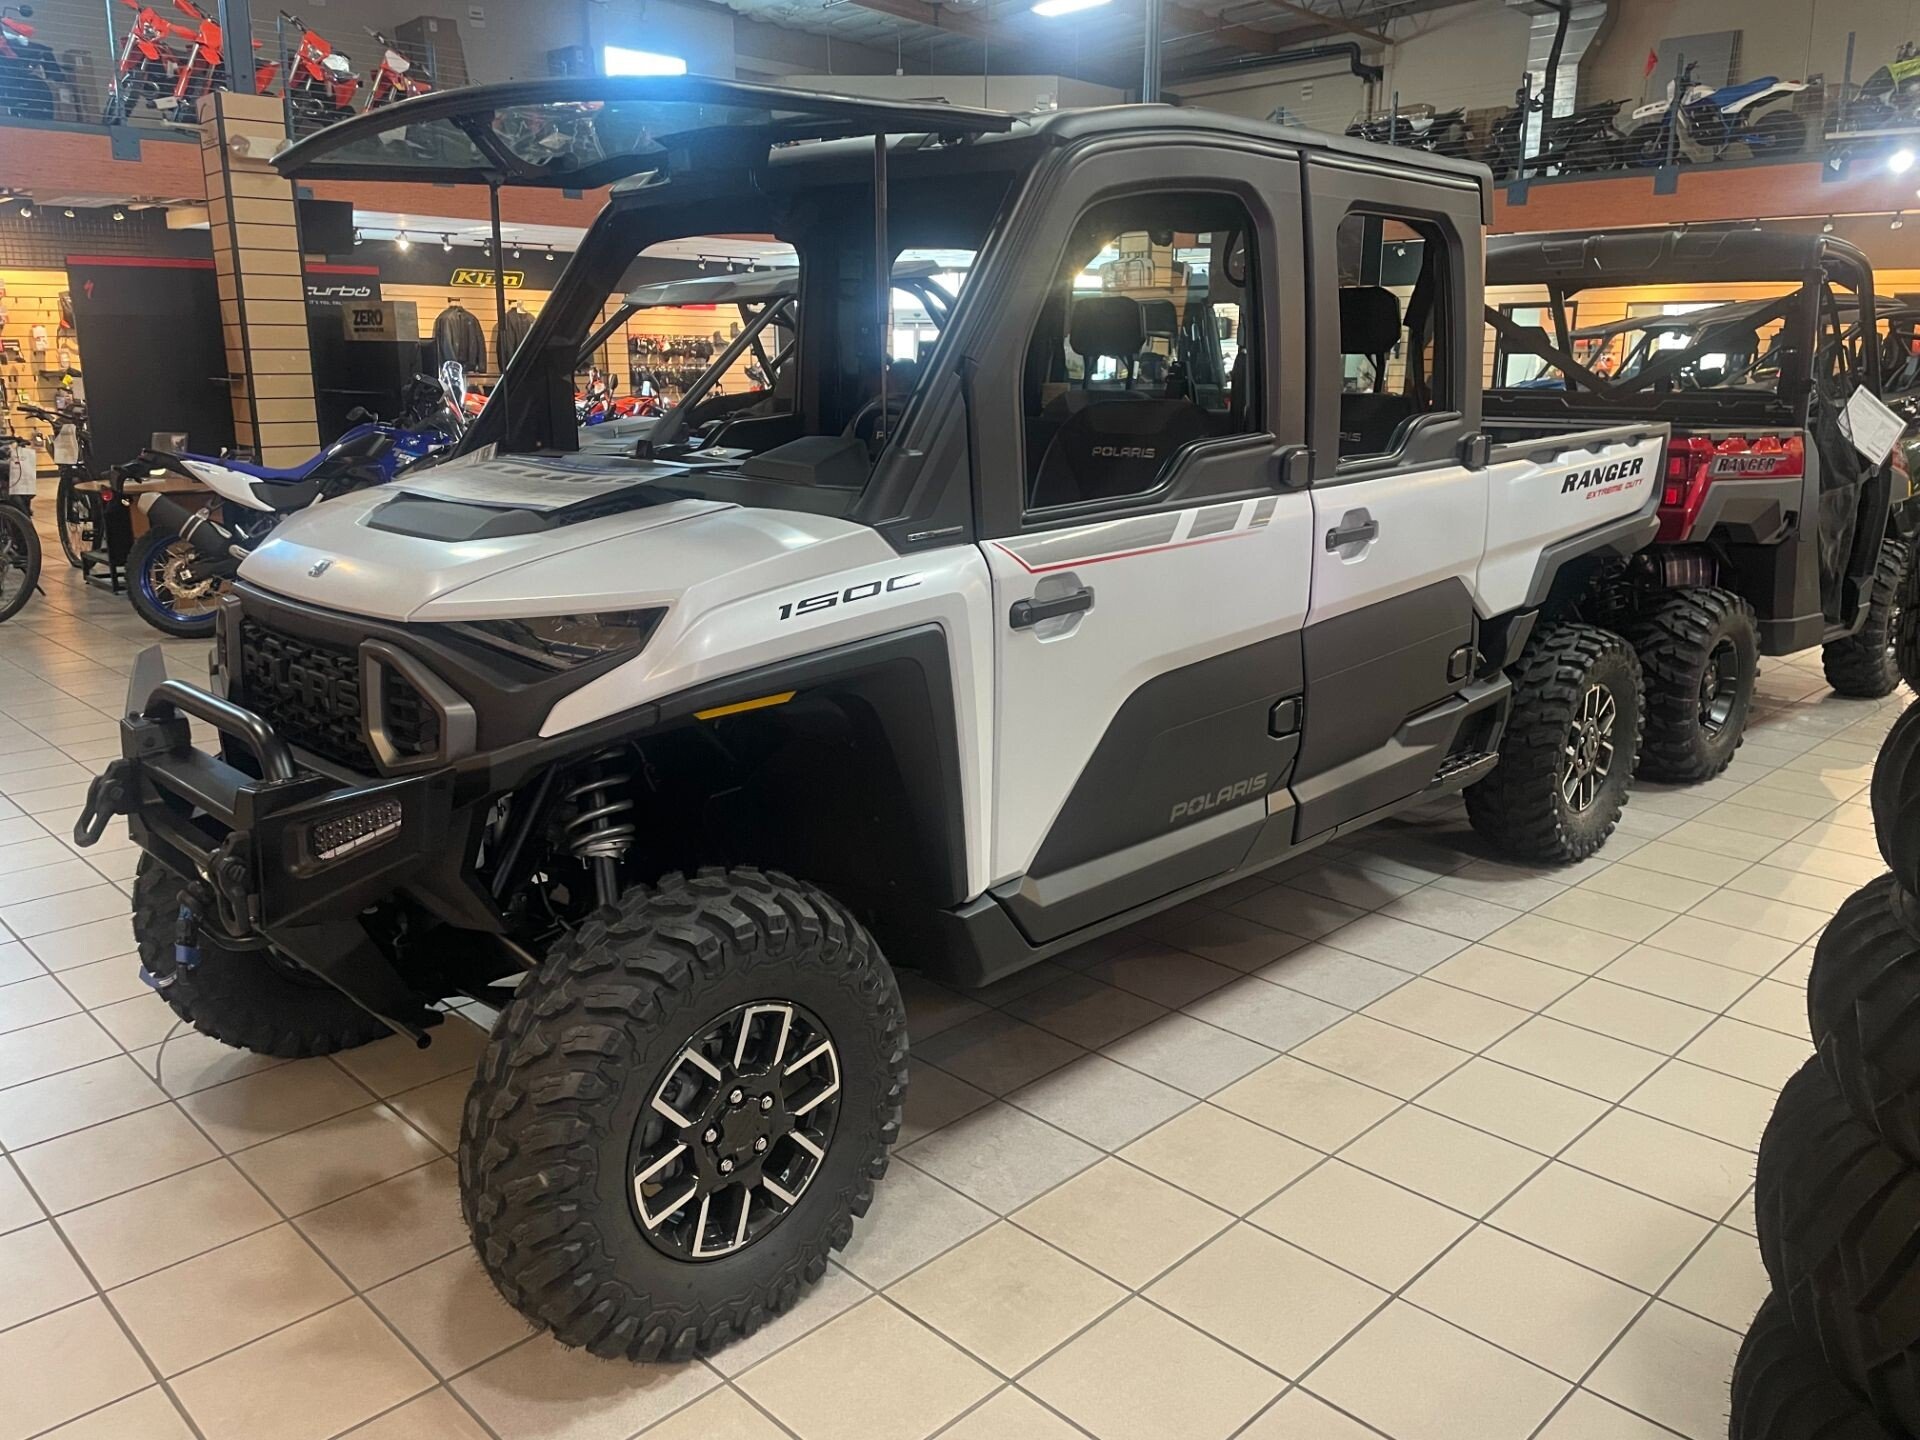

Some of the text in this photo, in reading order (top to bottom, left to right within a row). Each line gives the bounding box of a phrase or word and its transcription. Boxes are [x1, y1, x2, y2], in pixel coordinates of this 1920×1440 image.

[352, 308, 384, 327] ZERO
[1091, 446, 1156, 459] POLARIS
[1717, 457, 1777, 472] RANGER
[1561, 457, 1644, 495] RANGER
[1585, 479, 1644, 500] EXTREME DUTY
[242, 643, 361, 718] POLARIS
[1169, 772, 1269, 824] POLARIS
